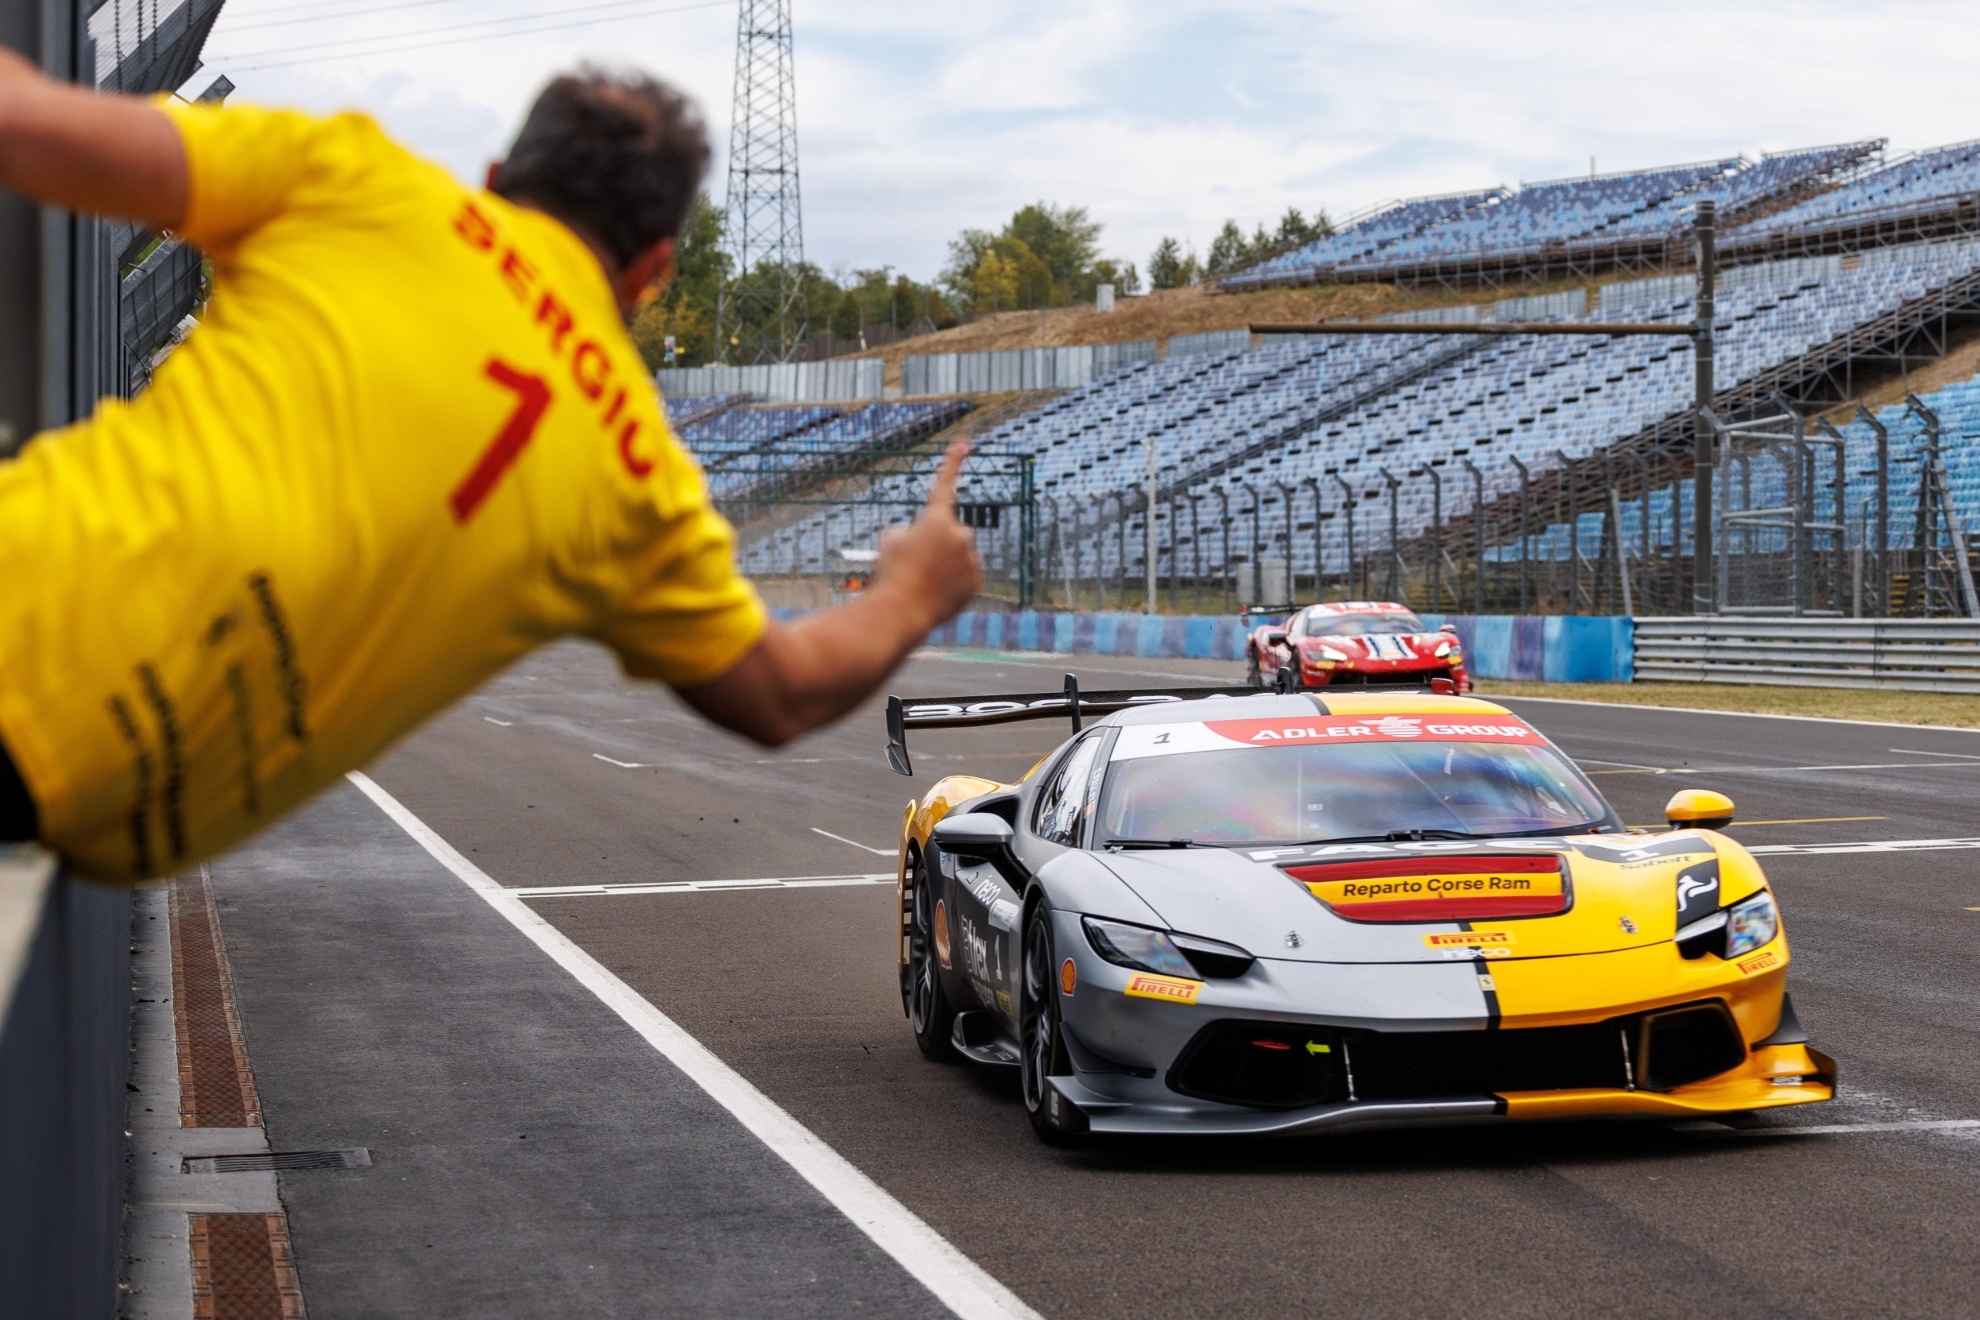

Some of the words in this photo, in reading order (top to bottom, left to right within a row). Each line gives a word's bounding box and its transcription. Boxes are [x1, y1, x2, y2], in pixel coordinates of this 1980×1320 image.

[449, 355, 553, 524] 7
[1153, 732, 1171, 744] 1
[1250, 725, 1375, 740] ADLER
[1425, 724, 1529, 738] GROUP
[1343, 880, 1422, 898] Reparto
[1427, 878, 1484, 892] Corse
[1489, 877, 1531, 890] Ram
[1429, 933, 1508, 945] PIRELLI
[1736, 952, 1779, 975] PIRELLI
[1131, 977, 1195, 999] PIRELLI
